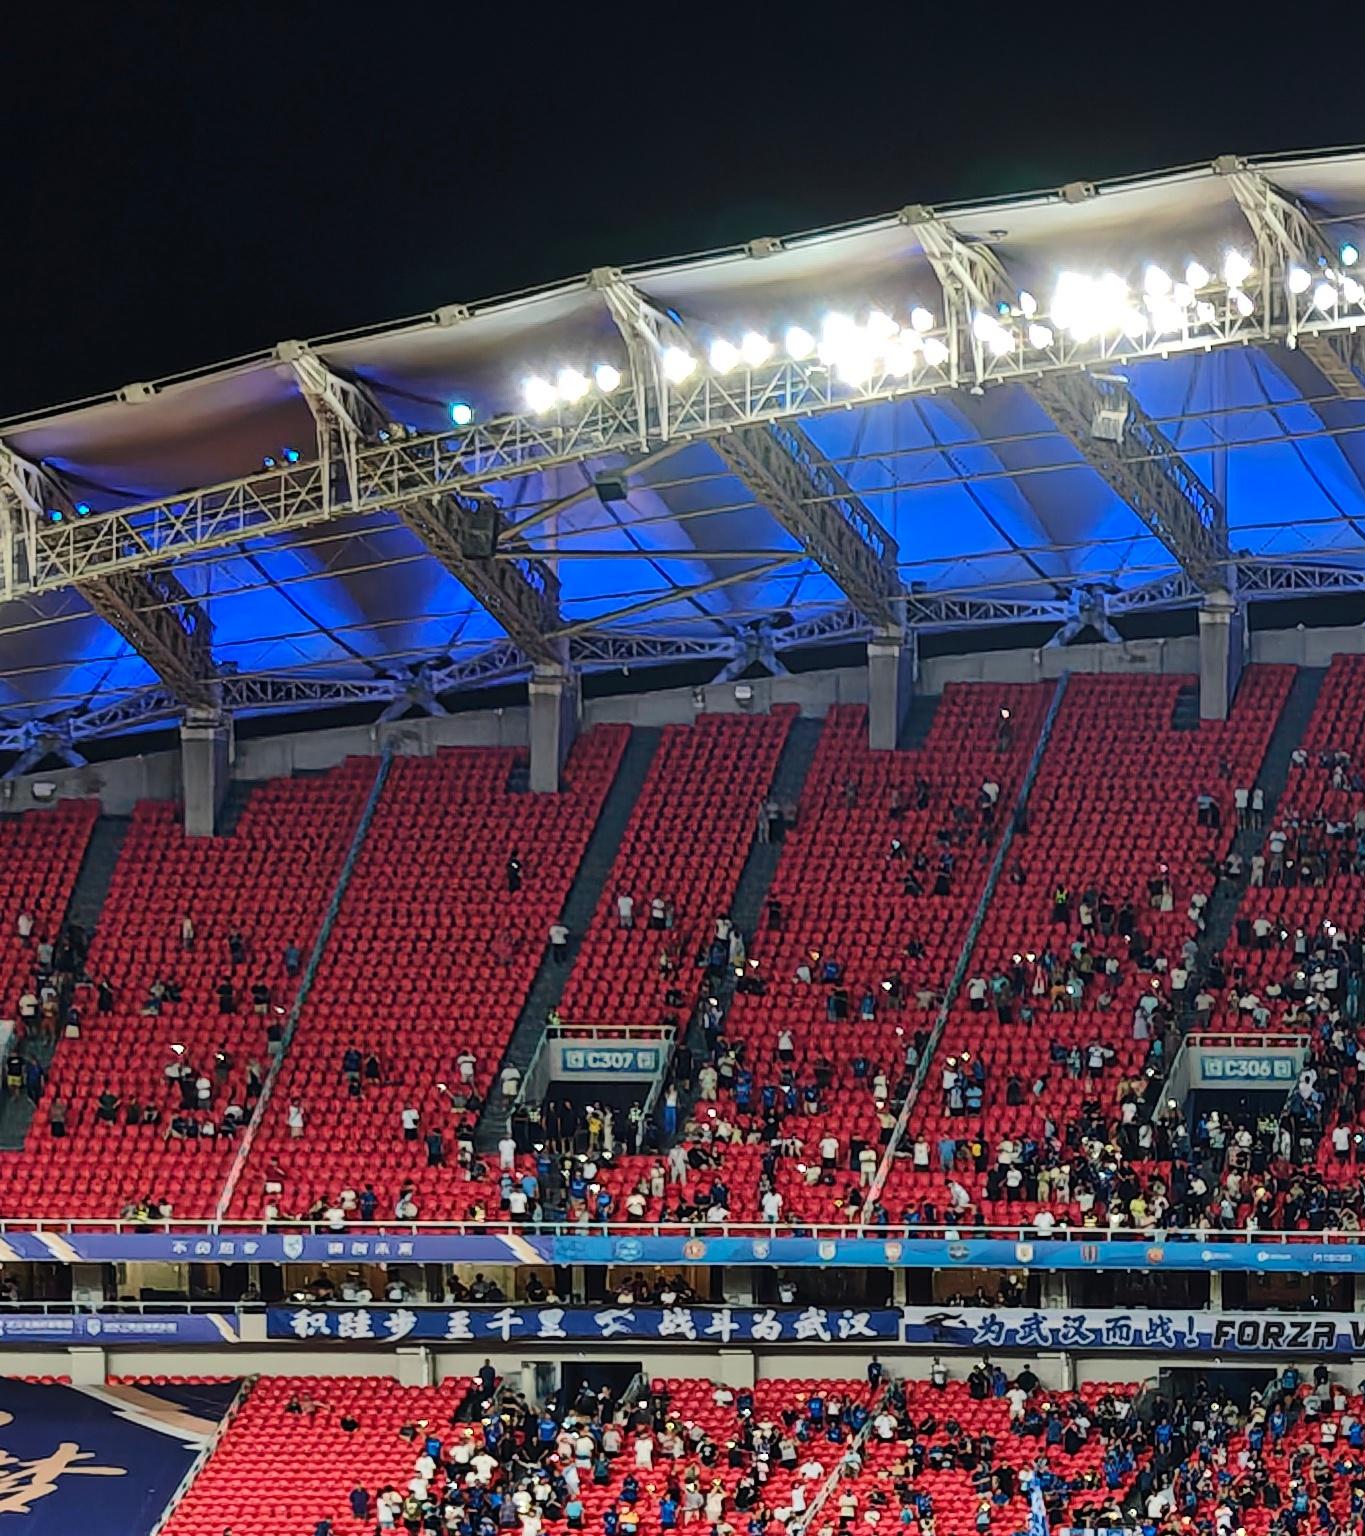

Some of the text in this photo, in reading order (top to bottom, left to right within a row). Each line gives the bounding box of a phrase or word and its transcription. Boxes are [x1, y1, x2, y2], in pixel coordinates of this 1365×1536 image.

[586, 1050, 634, 1070] C307
[1223, 1059, 1272, 1077] C306
[657, 1306, 879, 1343] 战斗为武汉
[1212, 1319, 1338, 1350] FORZA
